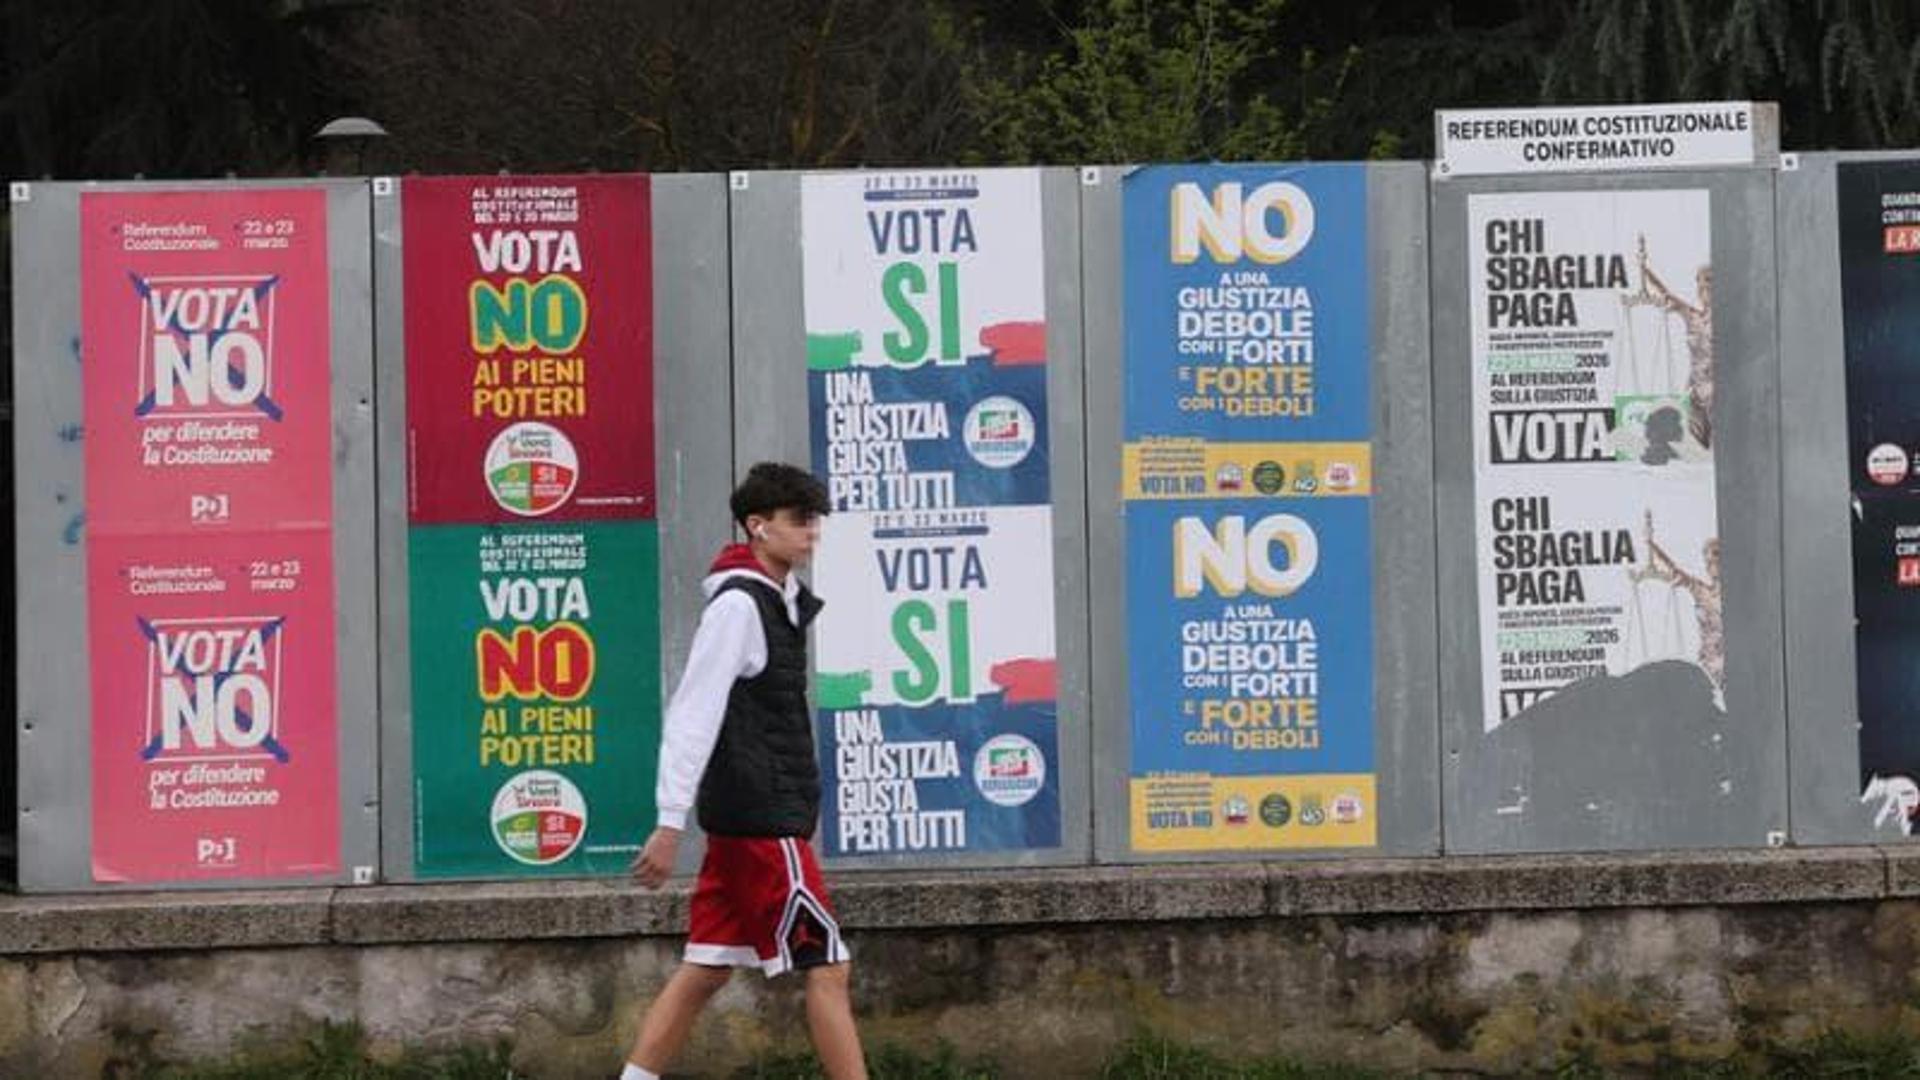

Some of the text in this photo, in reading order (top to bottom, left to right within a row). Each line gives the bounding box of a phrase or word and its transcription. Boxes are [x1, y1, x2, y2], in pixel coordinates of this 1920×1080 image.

[1448, 111, 1747, 140] REFERENDUM COSTITUZIONALE
[1523, 138, 1674, 162] CONFERMATIVO
[868, 208, 977, 255] VOTA
[1171, 182, 1314, 264] NO
[1485, 219, 1544, 255] CHI
[472, 231, 582, 273] VOTA
[1220, 273, 1268, 285] A UNA
[1486, 254, 1629, 290] SBAGLIA
[151, 288, 259, 331] VOTA
[470, 275, 587, 353] NO
[882, 261, 961, 363] SI
[1178, 287, 1311, 309] GIUSTIZIA
[1489, 293, 1577, 328] PAGA
[1178, 311, 1313, 337] DEBOLE
[1178, 341, 1216, 354] CON
[1226, 340, 1313, 363] FORTI
[154, 333, 264, 406] NO
[475, 359, 584, 386] AI PIENI
[1179, 366, 1313, 394] E FORTE
[1491, 371, 1596, 386] AL REFERENDUM
[474, 386, 587, 417] POTERI
[826, 372, 873, 404] UNA
[1491, 387, 1598, 403] SULLA GIUSTIZIA
[826, 402, 949, 440] GIUSTIZIA
[1178, 397, 1216, 411] CON
[1227, 396, 1313, 417] DEBOLI
[143, 421, 259, 443] per difendere
[1495, 412, 1616, 460] VOTA
[144, 444, 271, 464] la Costituzione
[827, 440, 908, 474] GIUSTA
[829, 472, 954, 511] PER TUTTI
[1492, 497, 1549, 531] CHI
[1173, 513, 1319, 598] NO
[1493, 529, 1635, 569] SBAGLIA
[877, 546, 986, 592] VOTA
[480, 578, 590, 620] VOTA
[1497, 570, 1584, 606] PAGA
[1224, 605, 1273, 618] A UNA
[1183, 620, 1315, 642] GIUSTIZIA
[157, 629, 266, 674] VOTA
[477, 622, 594, 701] NO
[891, 600, 971, 702] SI
[1183, 643, 1317, 672] DEBOLE
[1519, 648, 1605, 664] REFERENDUM
[1183, 674, 1220, 688] CON
[1231, 673, 1317, 697] FORTI
[1501, 667, 1541, 681] SULLA
[161, 674, 271, 749] NO
[482, 706, 593, 734] AI PIENI
[835, 711, 883, 743] UNA
[1185, 700, 1316, 728] E FORTE
[480, 734, 593, 767] POTERI
[1185, 731, 1220, 745] CON
[1232, 730, 1319, 750] DEBOLI
[151, 763, 265, 789] per difendere
[837, 742, 960, 779] GIUSTIZIA
[151, 787, 278, 809] la Costituzione
[838, 780, 918, 812] GIUSTA
[839, 811, 966, 851] PER TUTTI
